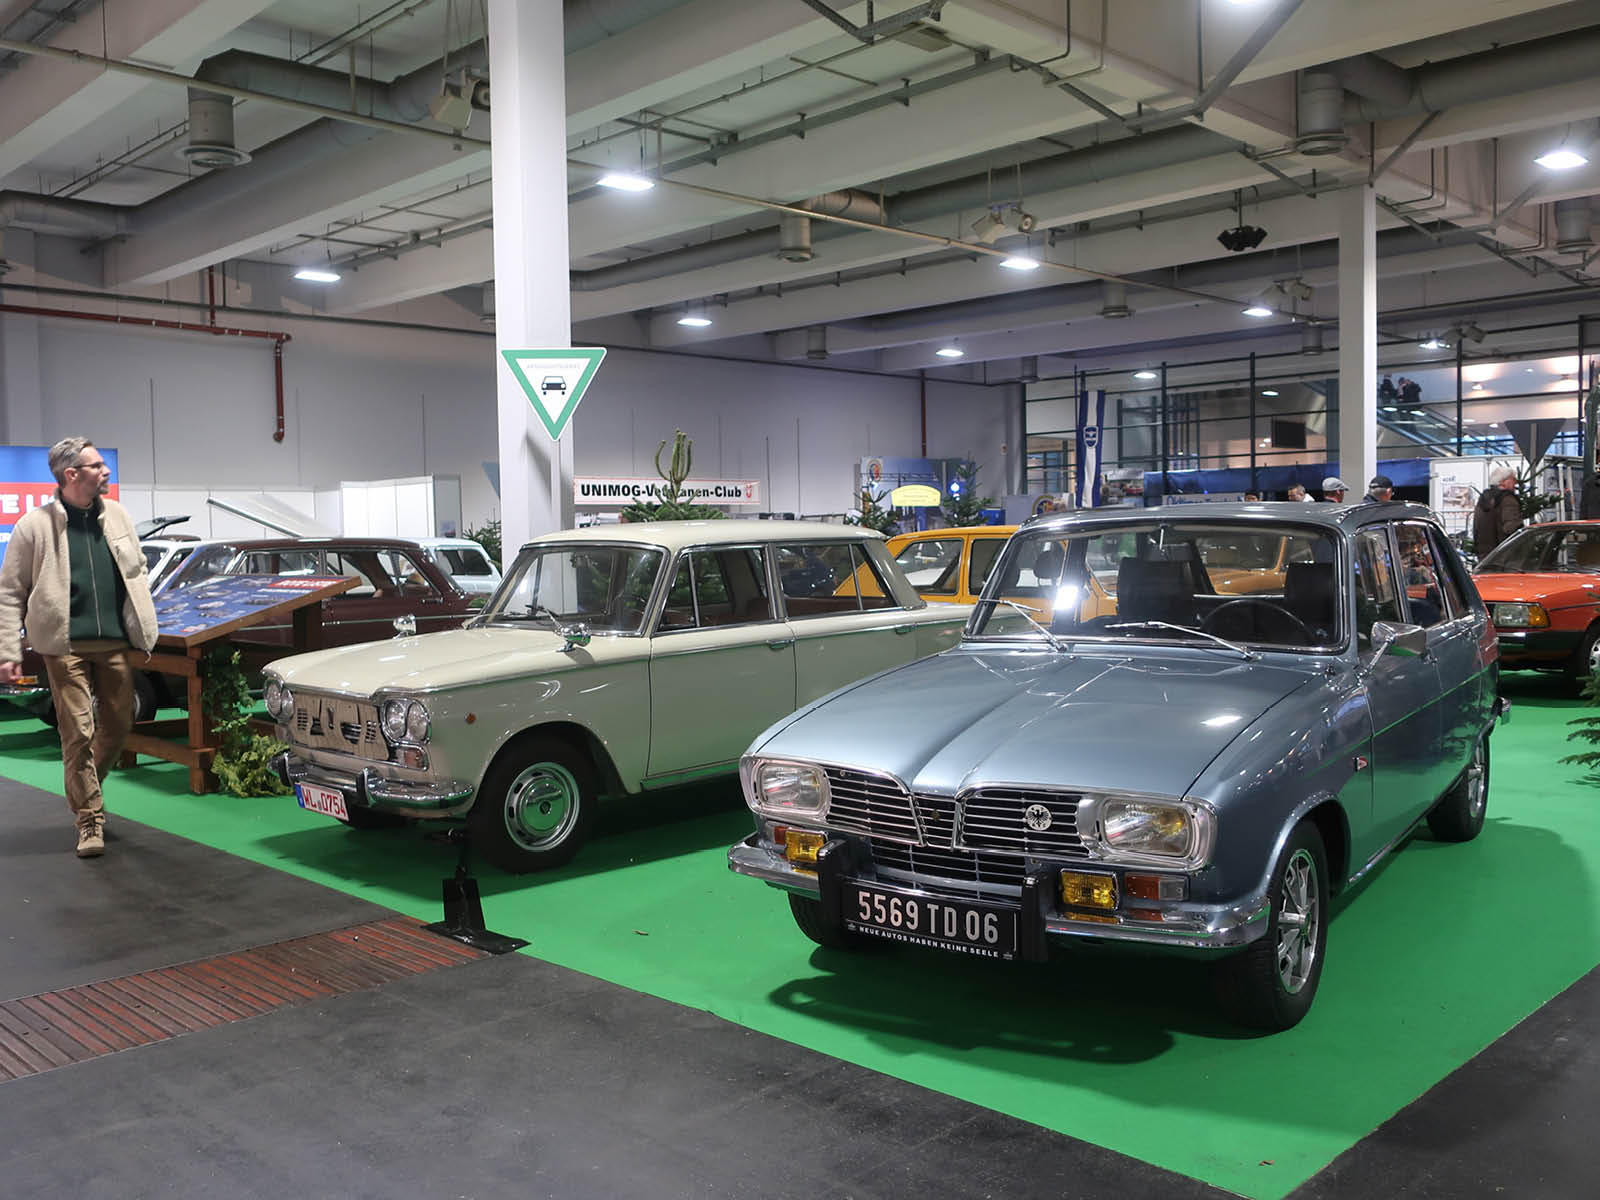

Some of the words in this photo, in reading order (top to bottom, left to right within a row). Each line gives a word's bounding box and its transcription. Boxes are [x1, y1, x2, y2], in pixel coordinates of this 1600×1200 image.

[25, 494, 56, 512] LI
[302, 788, 316, 808] WL
[858, 890, 919, 930] 5569
[926, 903, 957, 938] TD
[965, 910, 999, 944] 06
[859, 927, 880, 936] NEUE
[881, 930, 908, 941] AUTOS
[909, 936, 938, 947] HABEN
[940, 942, 968, 953] KEINE
[969, 947, 999, 957] SEELE
